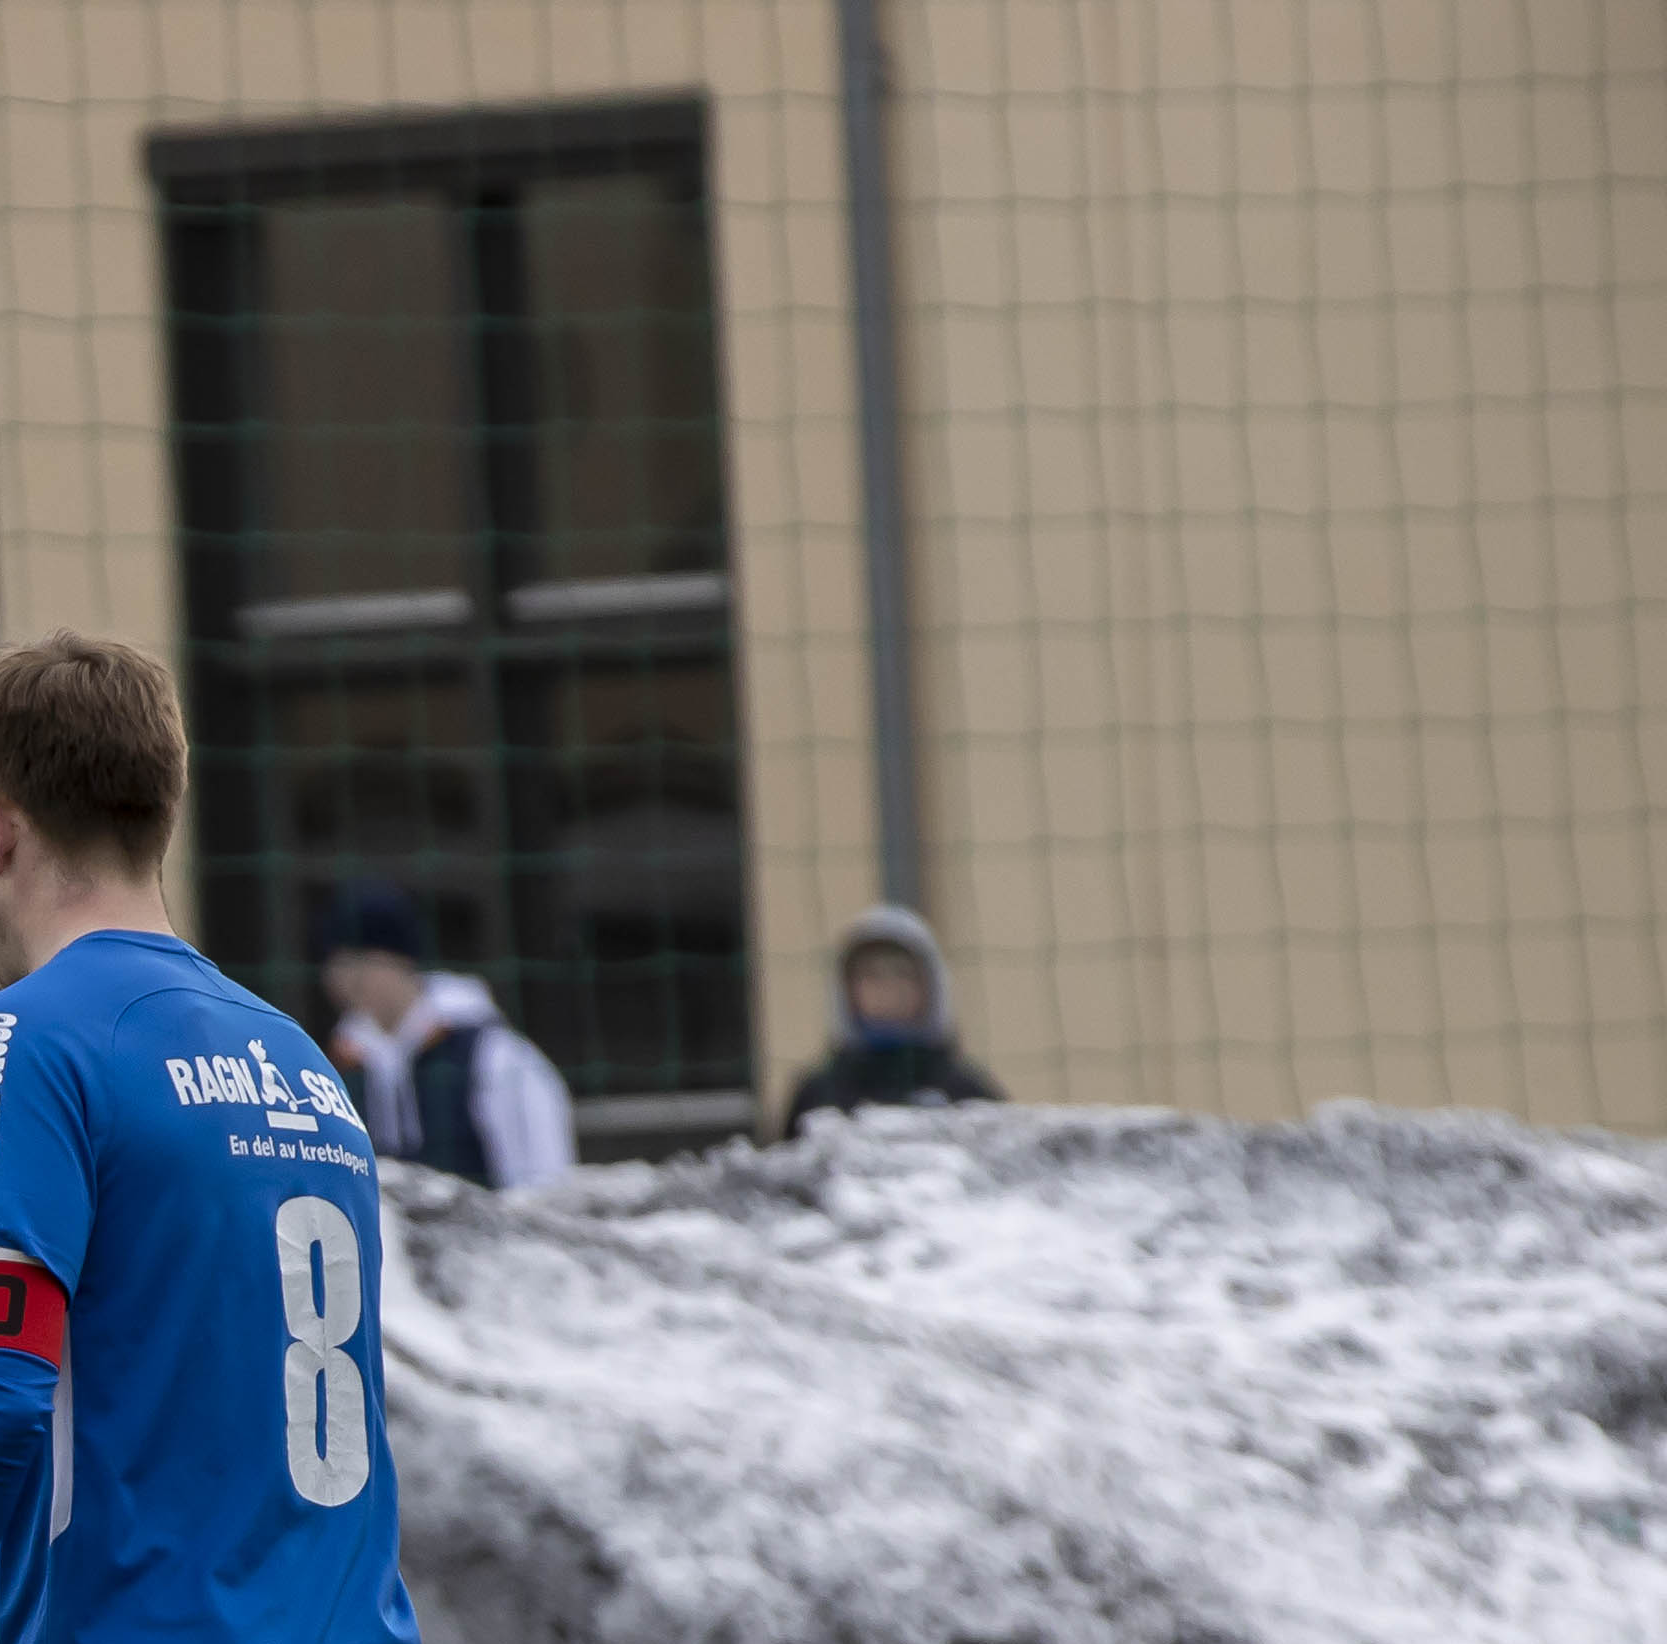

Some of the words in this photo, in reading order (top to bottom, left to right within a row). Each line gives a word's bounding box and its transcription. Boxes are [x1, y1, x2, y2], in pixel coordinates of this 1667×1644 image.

[166, 1055, 260, 1105] RAGN
[229, 1134, 249, 1156] En
[252, 1135, 275, 1157] del
[279, 1143, 296, 1159] av
[276, 1196, 369, 1507] 8
